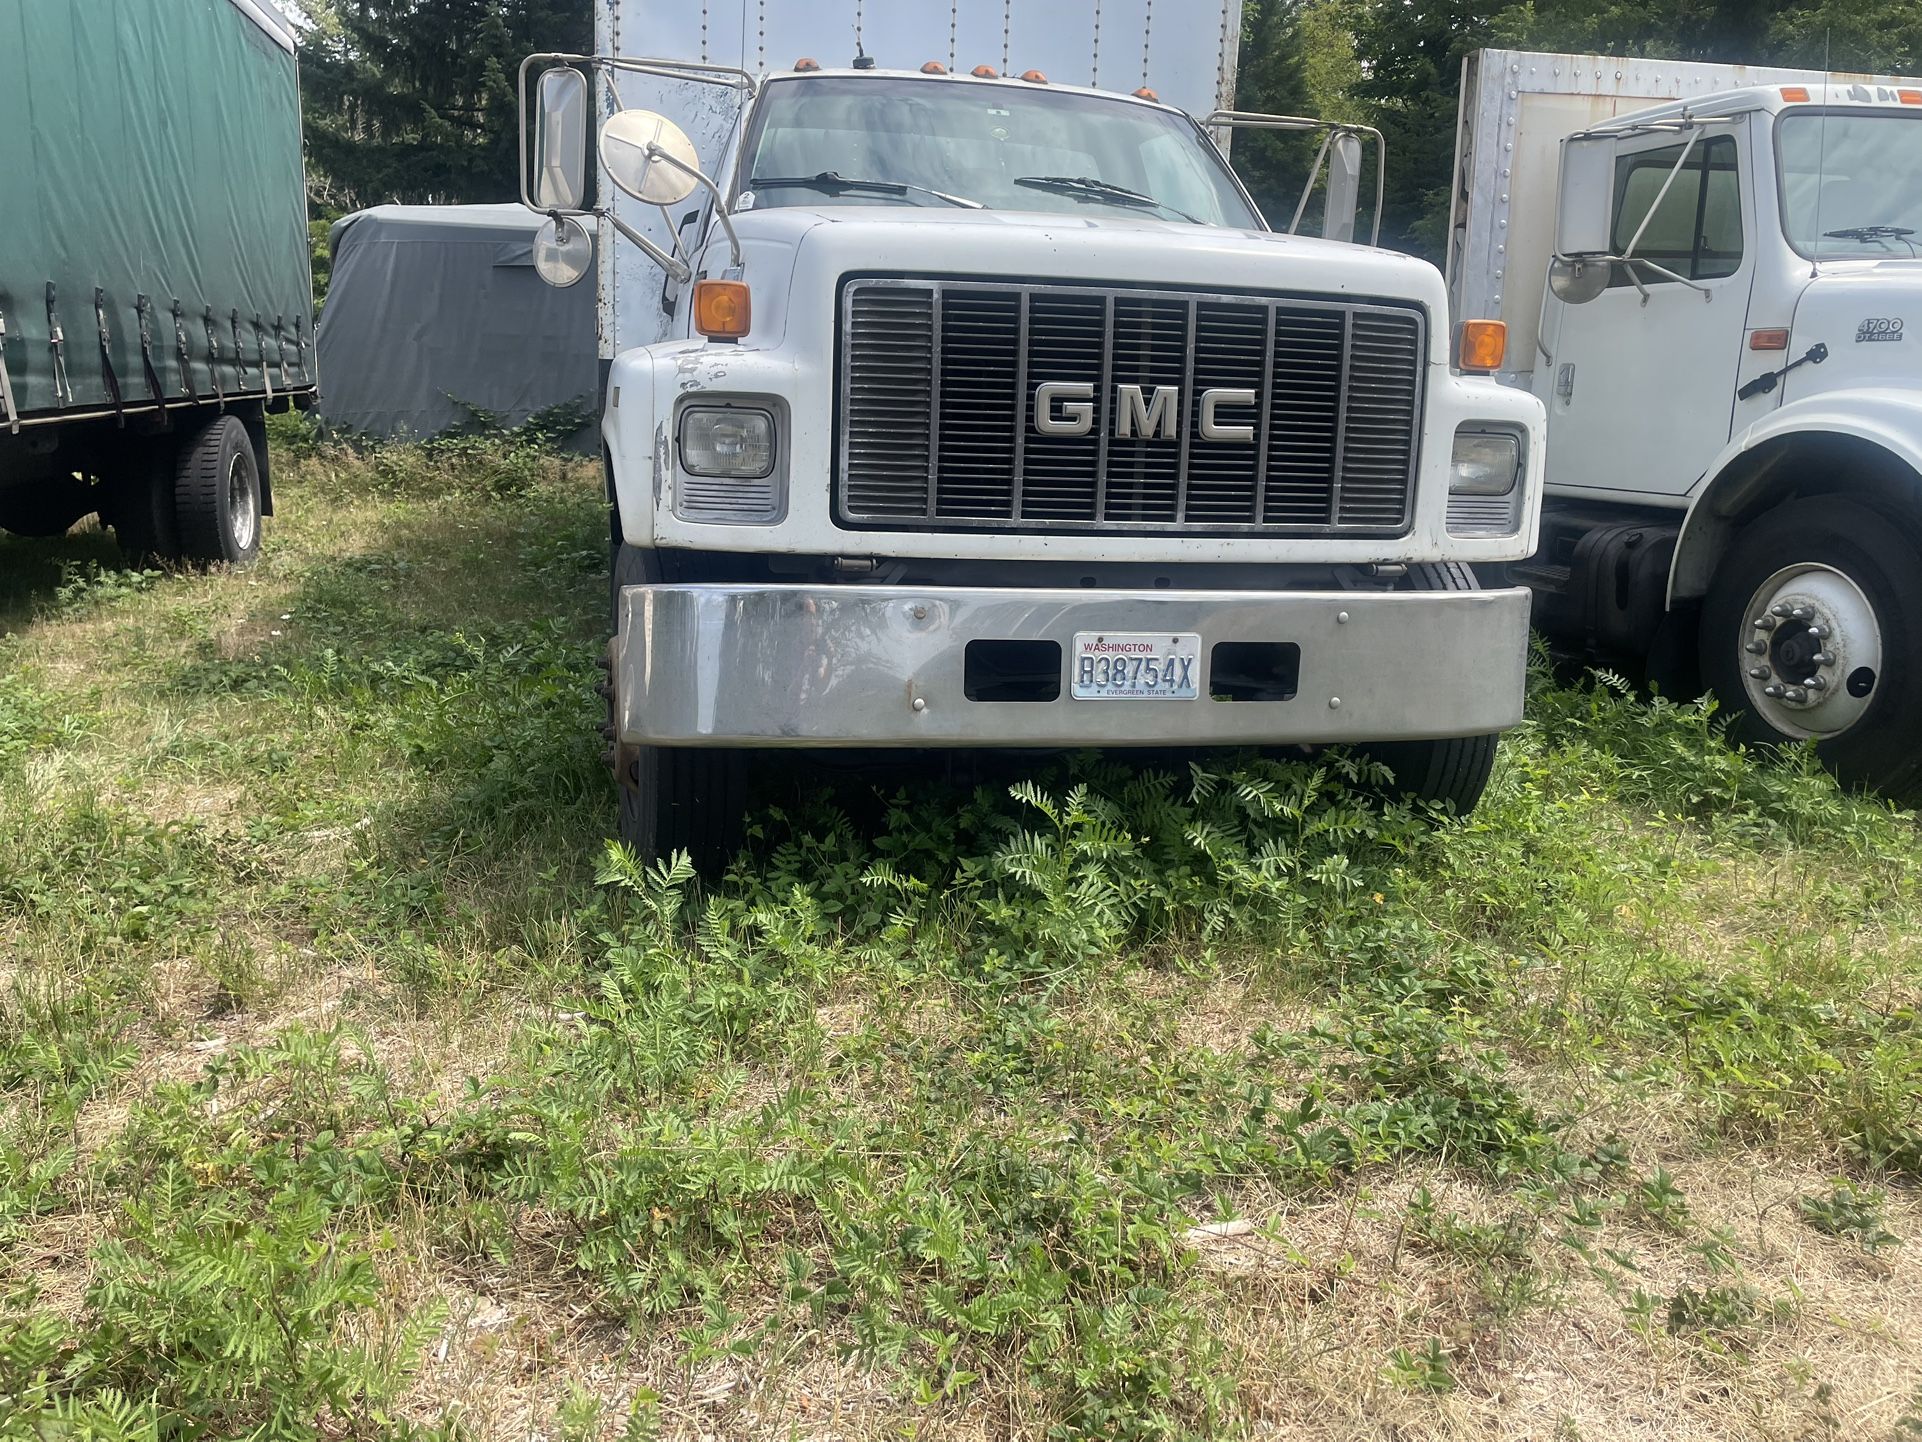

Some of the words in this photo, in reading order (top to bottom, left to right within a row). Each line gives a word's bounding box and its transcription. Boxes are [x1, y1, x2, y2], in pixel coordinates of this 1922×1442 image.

[1858, 318, 1903, 332] 4700
[1034, 381, 1256, 442] GMC
[1083, 642, 1153, 653] WASHINGTON
[1079, 654, 1194, 689] B38754X
